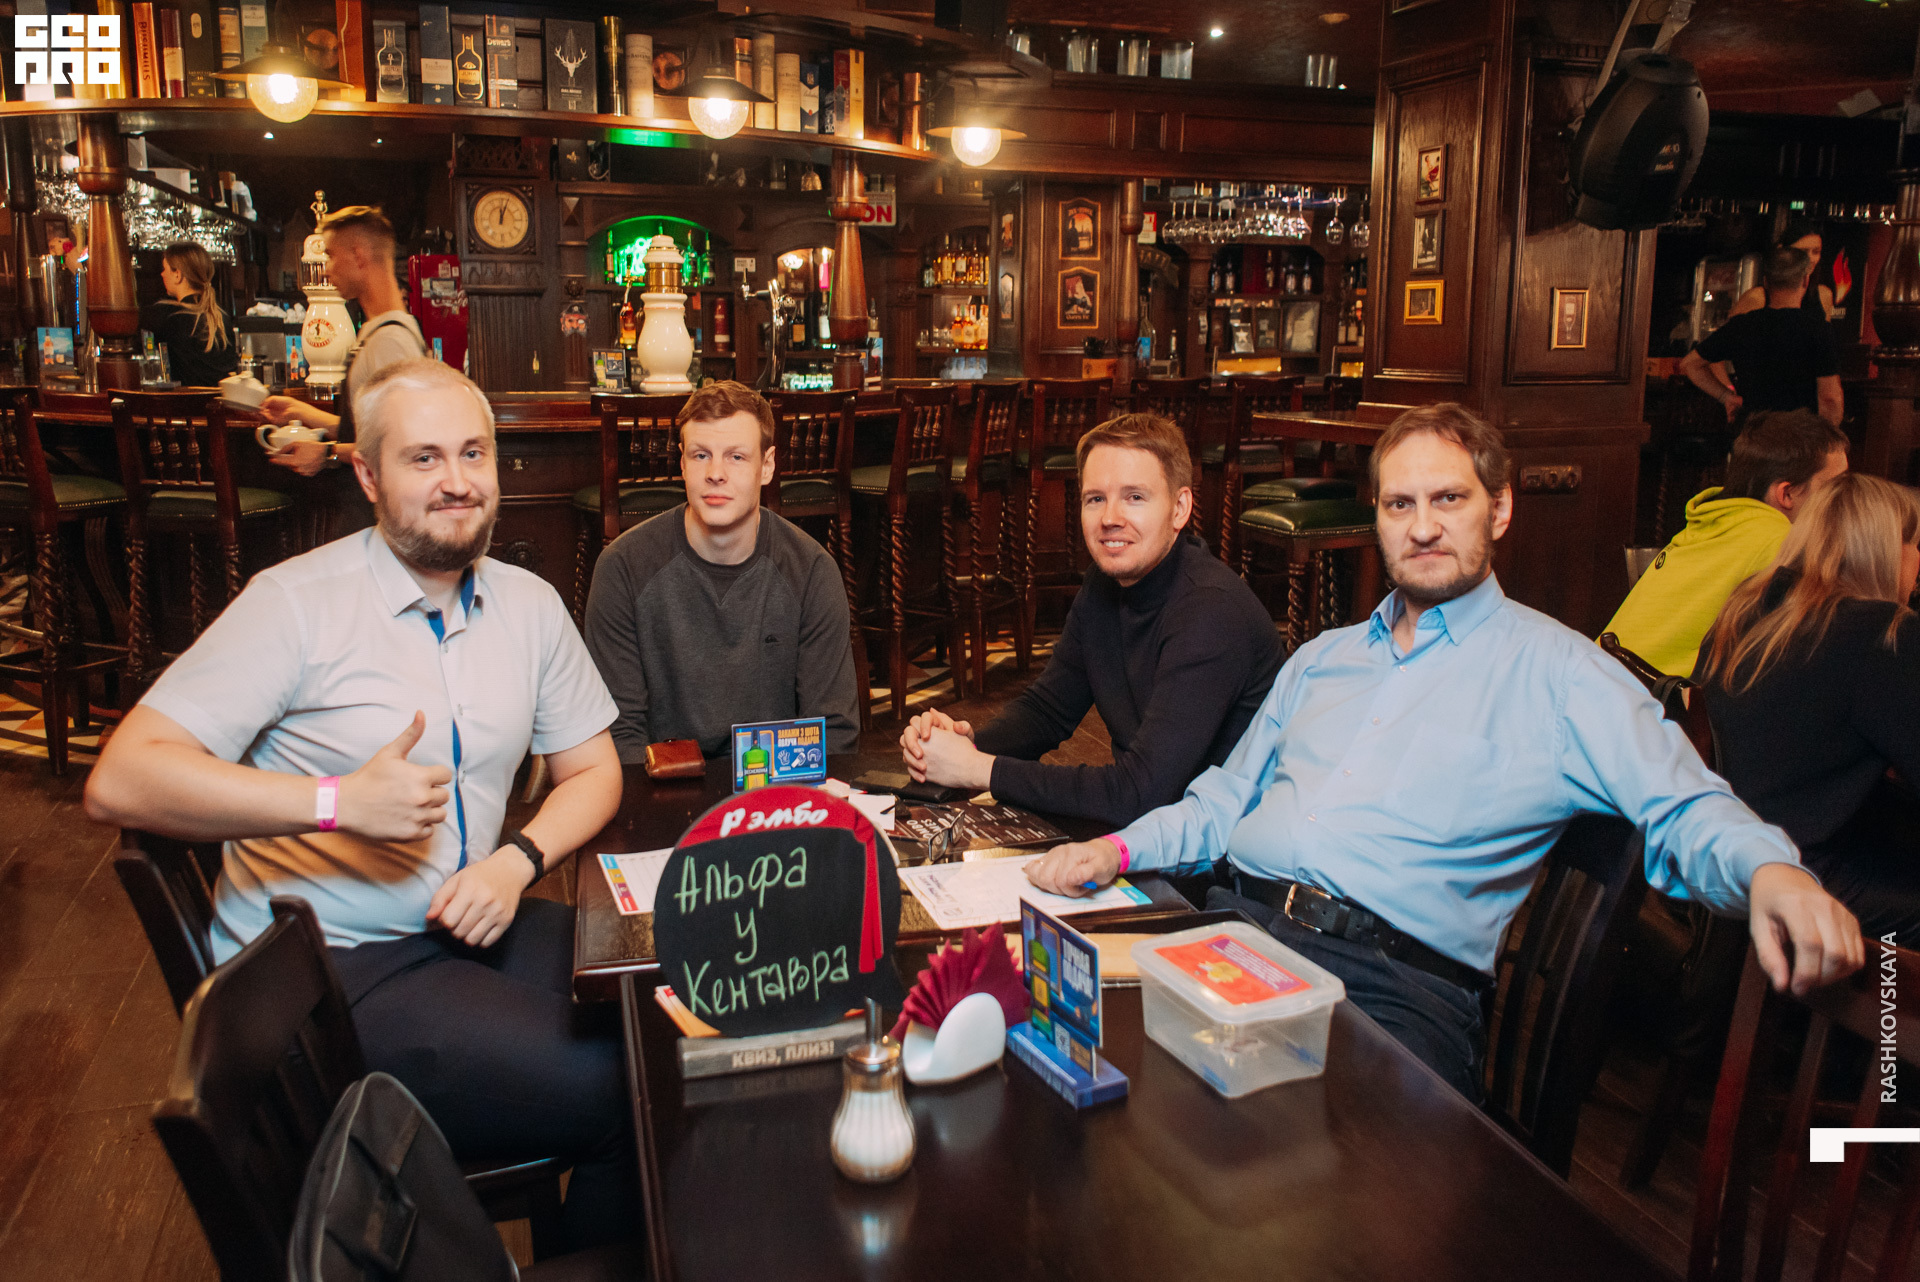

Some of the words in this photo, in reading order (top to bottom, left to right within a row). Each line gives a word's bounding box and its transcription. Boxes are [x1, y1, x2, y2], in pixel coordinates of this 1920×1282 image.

[719, 800, 829, 837] Рэмбо
[674, 847, 807, 915] Альфа
[683, 945, 850, 1016] Кентавра
[732, 1048, 782, 1069] КВИЗ,
[785, 1040, 835, 1061] ПЛИЗ!
